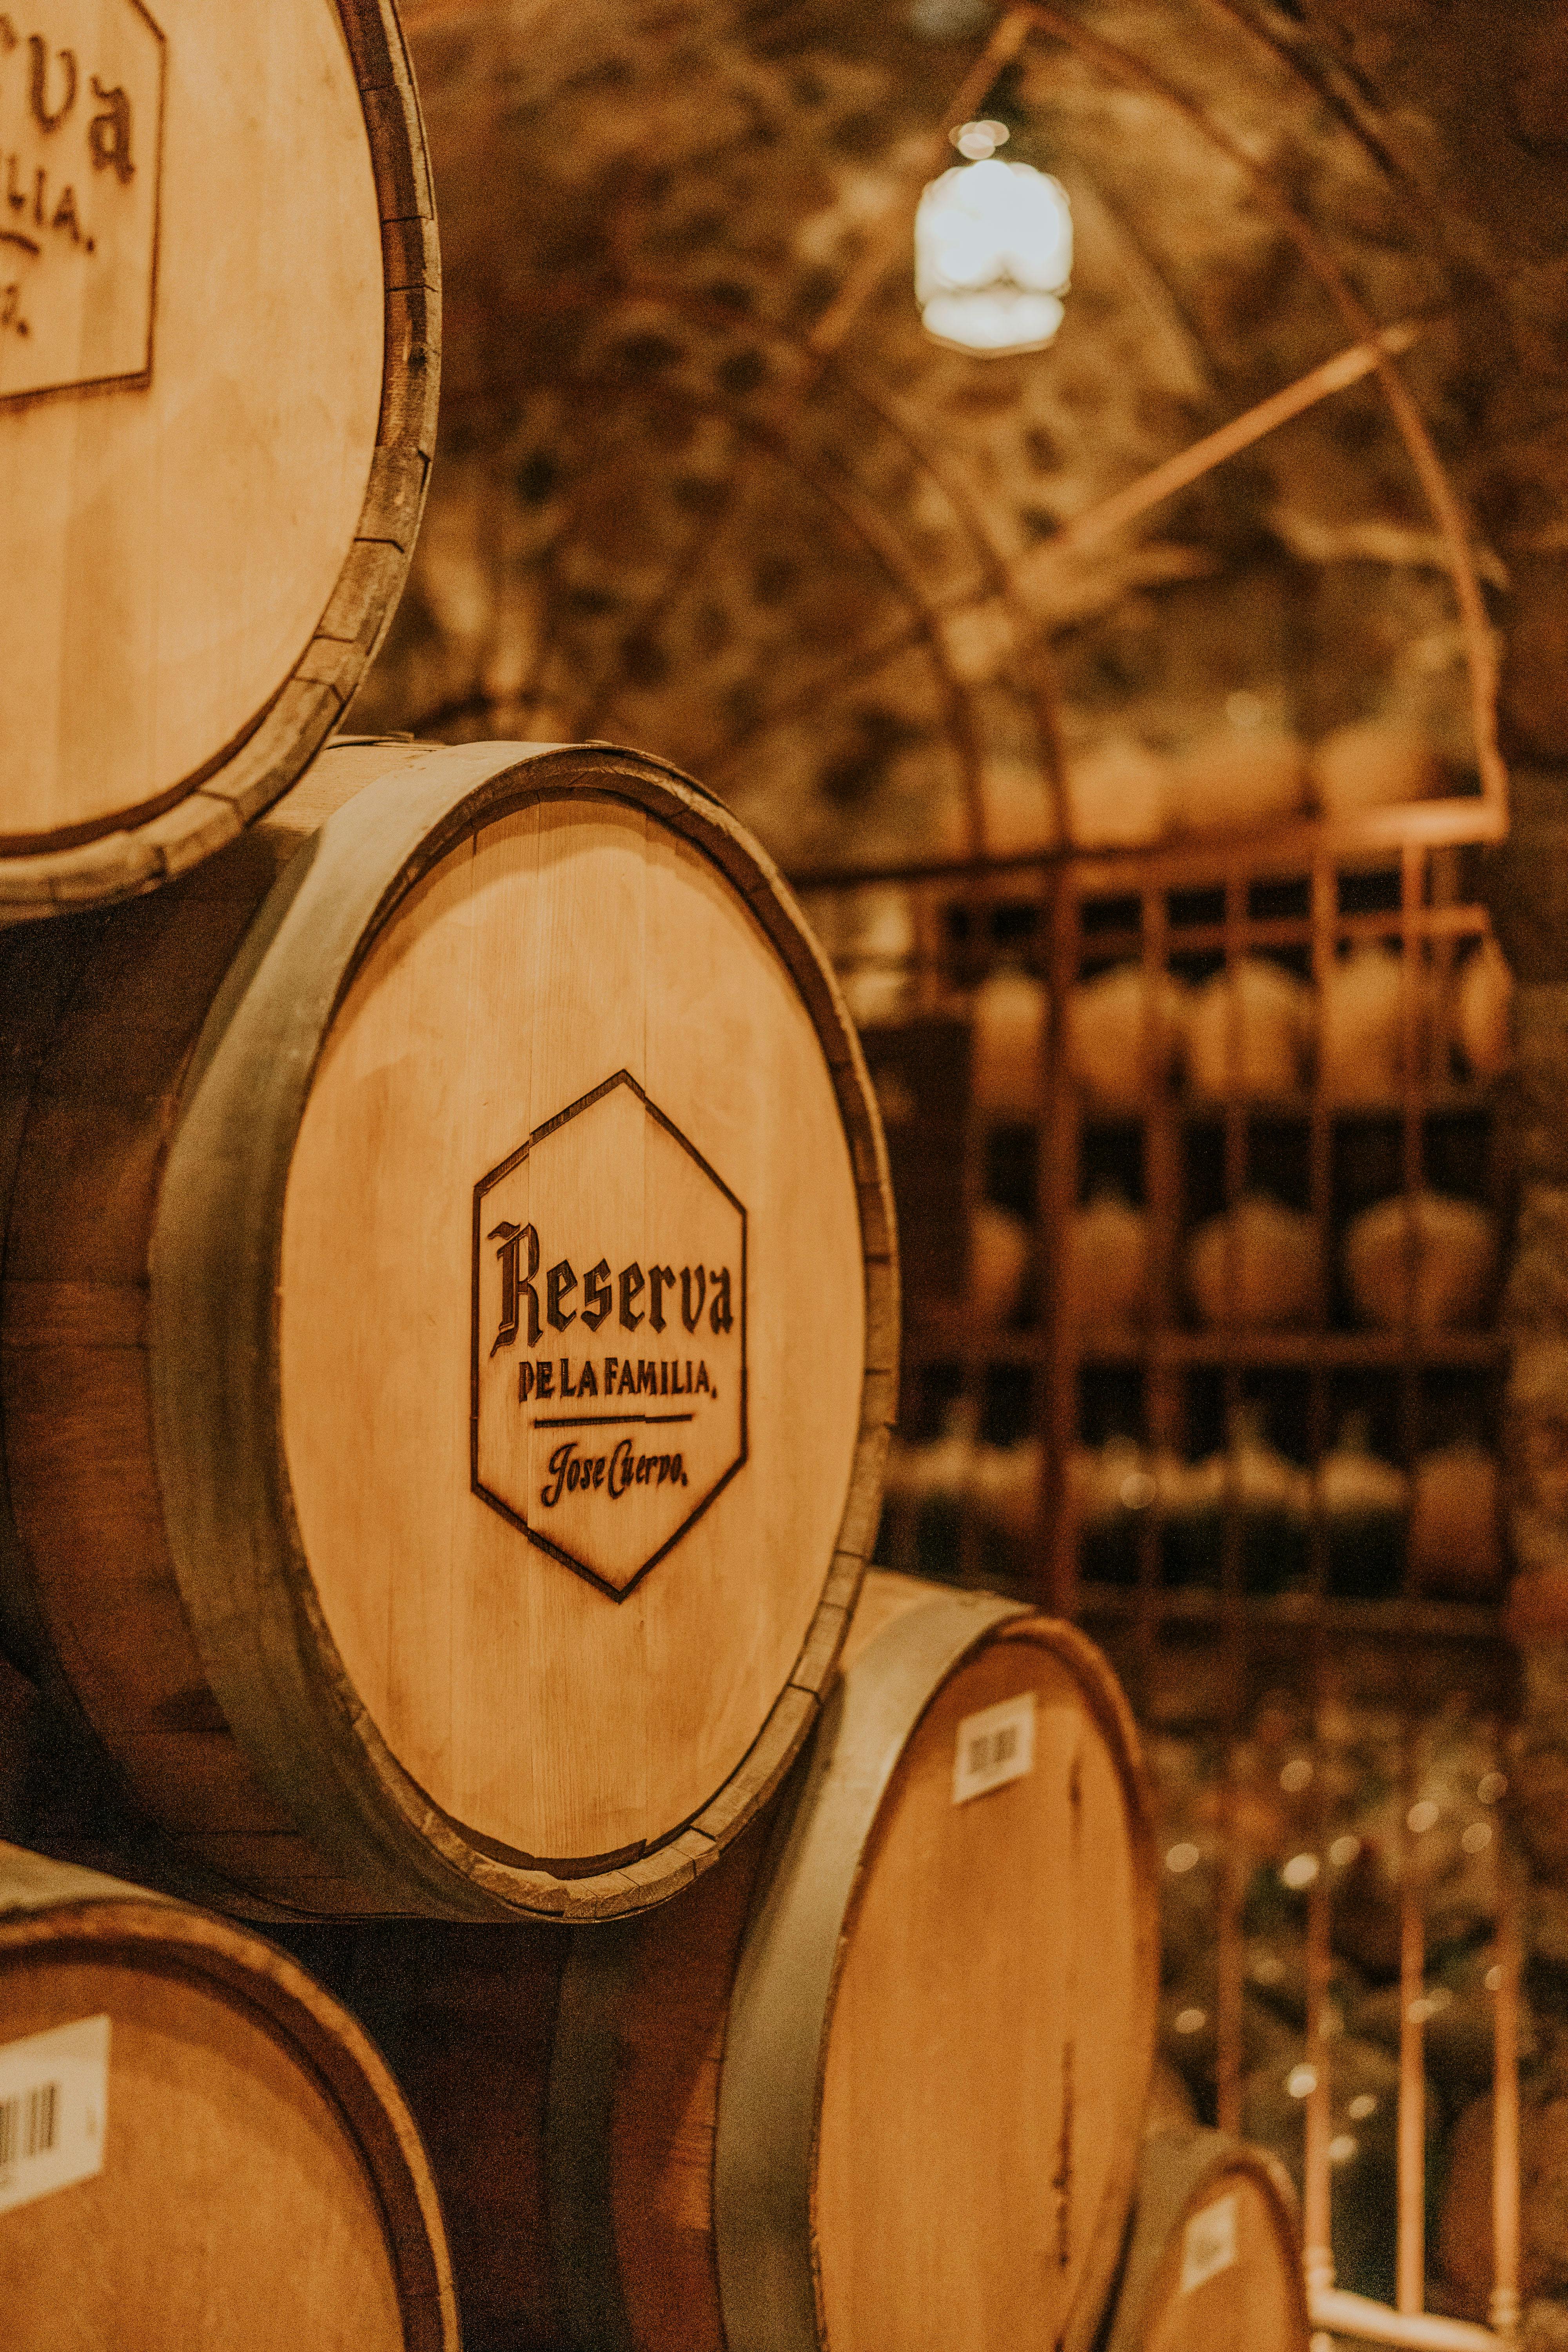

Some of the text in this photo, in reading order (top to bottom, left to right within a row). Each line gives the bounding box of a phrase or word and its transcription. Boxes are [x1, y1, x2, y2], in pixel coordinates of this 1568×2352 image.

[0, 13, 135, 184] va
[487, 1221, 733, 1357] Reserva
[518, 1361, 555, 1403] DE
[560, 1357, 599, 1398] LA
[541, 1441, 606, 1507] Jose
